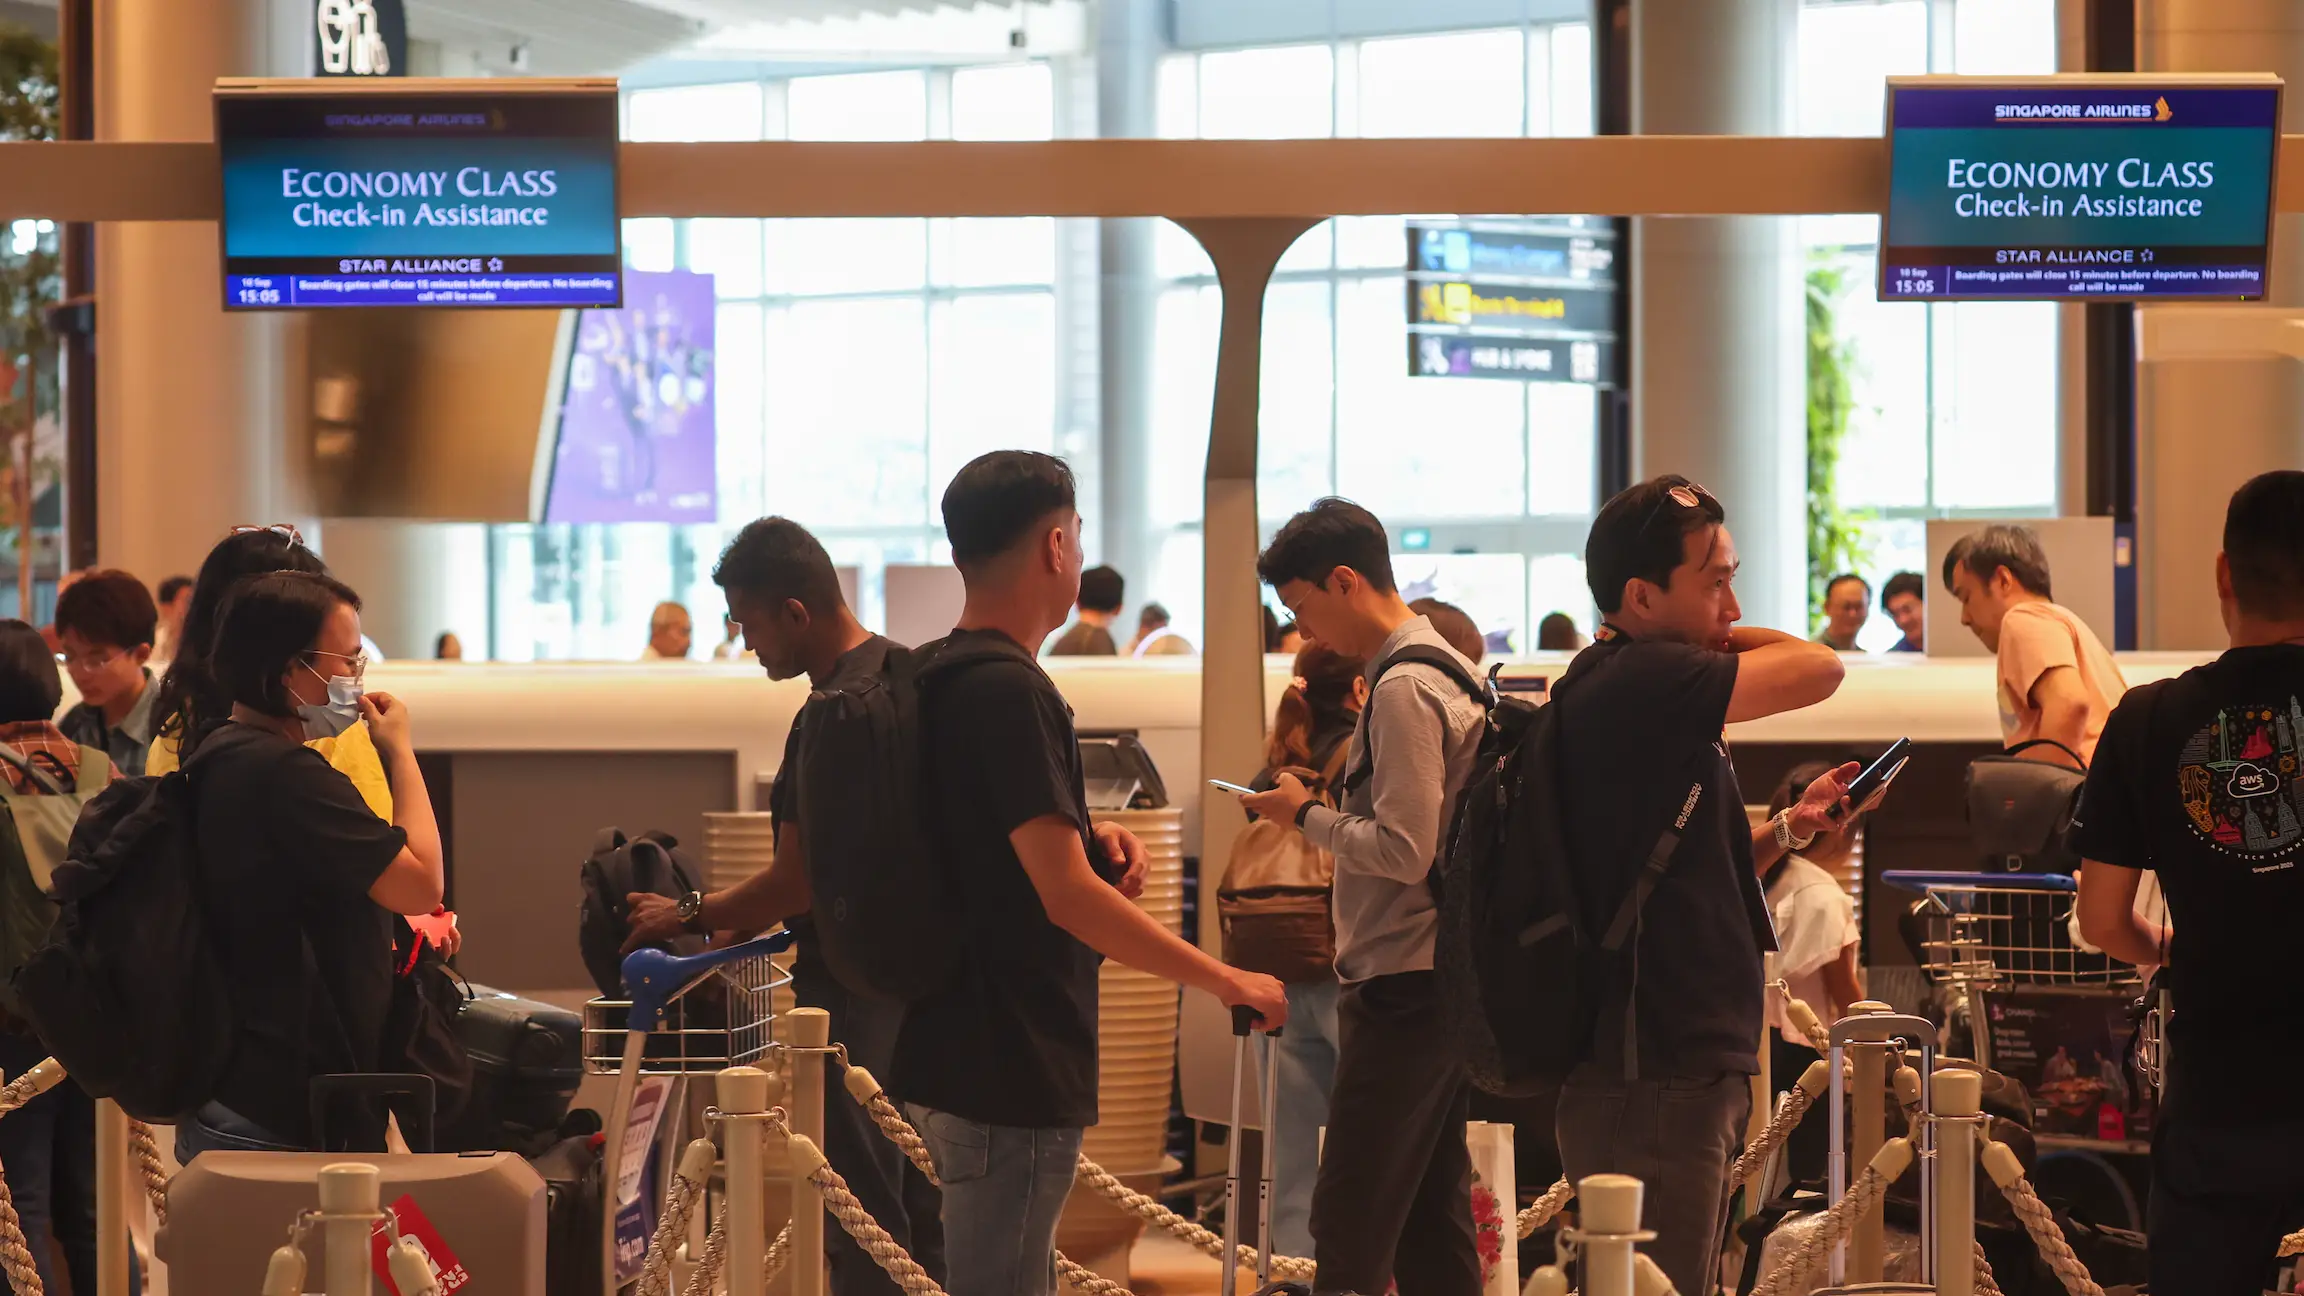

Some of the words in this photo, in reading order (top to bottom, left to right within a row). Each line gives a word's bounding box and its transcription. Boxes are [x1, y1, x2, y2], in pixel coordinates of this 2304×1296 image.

[1995, 105, 2081, 118] SINGAPORE
[2084, 104, 2152, 117] AIRLINES
[1947, 159, 2109, 189] ECONOMY
[2117, 157, 2214, 188] CLASS
[282, 168, 447, 199] ECONOMY
[456, 166, 558, 198] CLASS
[1954, 193, 2064, 218] Check-in
[2072, 193, 2203, 217] Assistance
[293, 203, 406, 228] Check-in
[413, 202, 549, 227] Assistance
[1996, 250, 2041, 264] STAR
[2045, 249, 2134, 263] ALLIANCE
[339, 258, 387, 273] STAR
[391, 258, 482, 272] ALLIANCE
[1913, 268, 1928, 279] Sep
[1955, 270, 1997, 282] Boarding
[1998, 271, 2024, 282] gates
[2025, 270, 2043, 280] will
[2044, 270, 2067, 280] close
[2069, 270, 2080, 280] 15
[2082, 270, 2119, 280] minutes
[2120, 270, 2150, 280] before
[2152, 270, 2200, 282] departure.
[2202, 269, 2216, 280] No
[2217, 269, 2259, 282] boarding
[299, 278, 343, 292] Boarding
[371, 279, 388, 290] will
[430, 278, 468, 290] minutes
[469, 279, 501, 290] before
[502, 278, 552, 291] departure.
[553, 278, 567, 288] No
[568, 277, 614, 291] boarding
[1895, 280, 1934, 294] 15:05
[2068, 282, 2085, 292] call
[2086, 282, 2103, 292] will
[2104, 282, 2117, 292] be
[2118, 282, 2145, 292] made
[239, 289, 280, 304] 15:05
[416, 291, 435, 301] call
[435, 291, 454, 301] will
[454, 291, 467, 301] be
[468, 290, 497, 301] made
[2239, 774, 2263, 785] aws
[1679, 783, 1702, 829] AMERICAN
